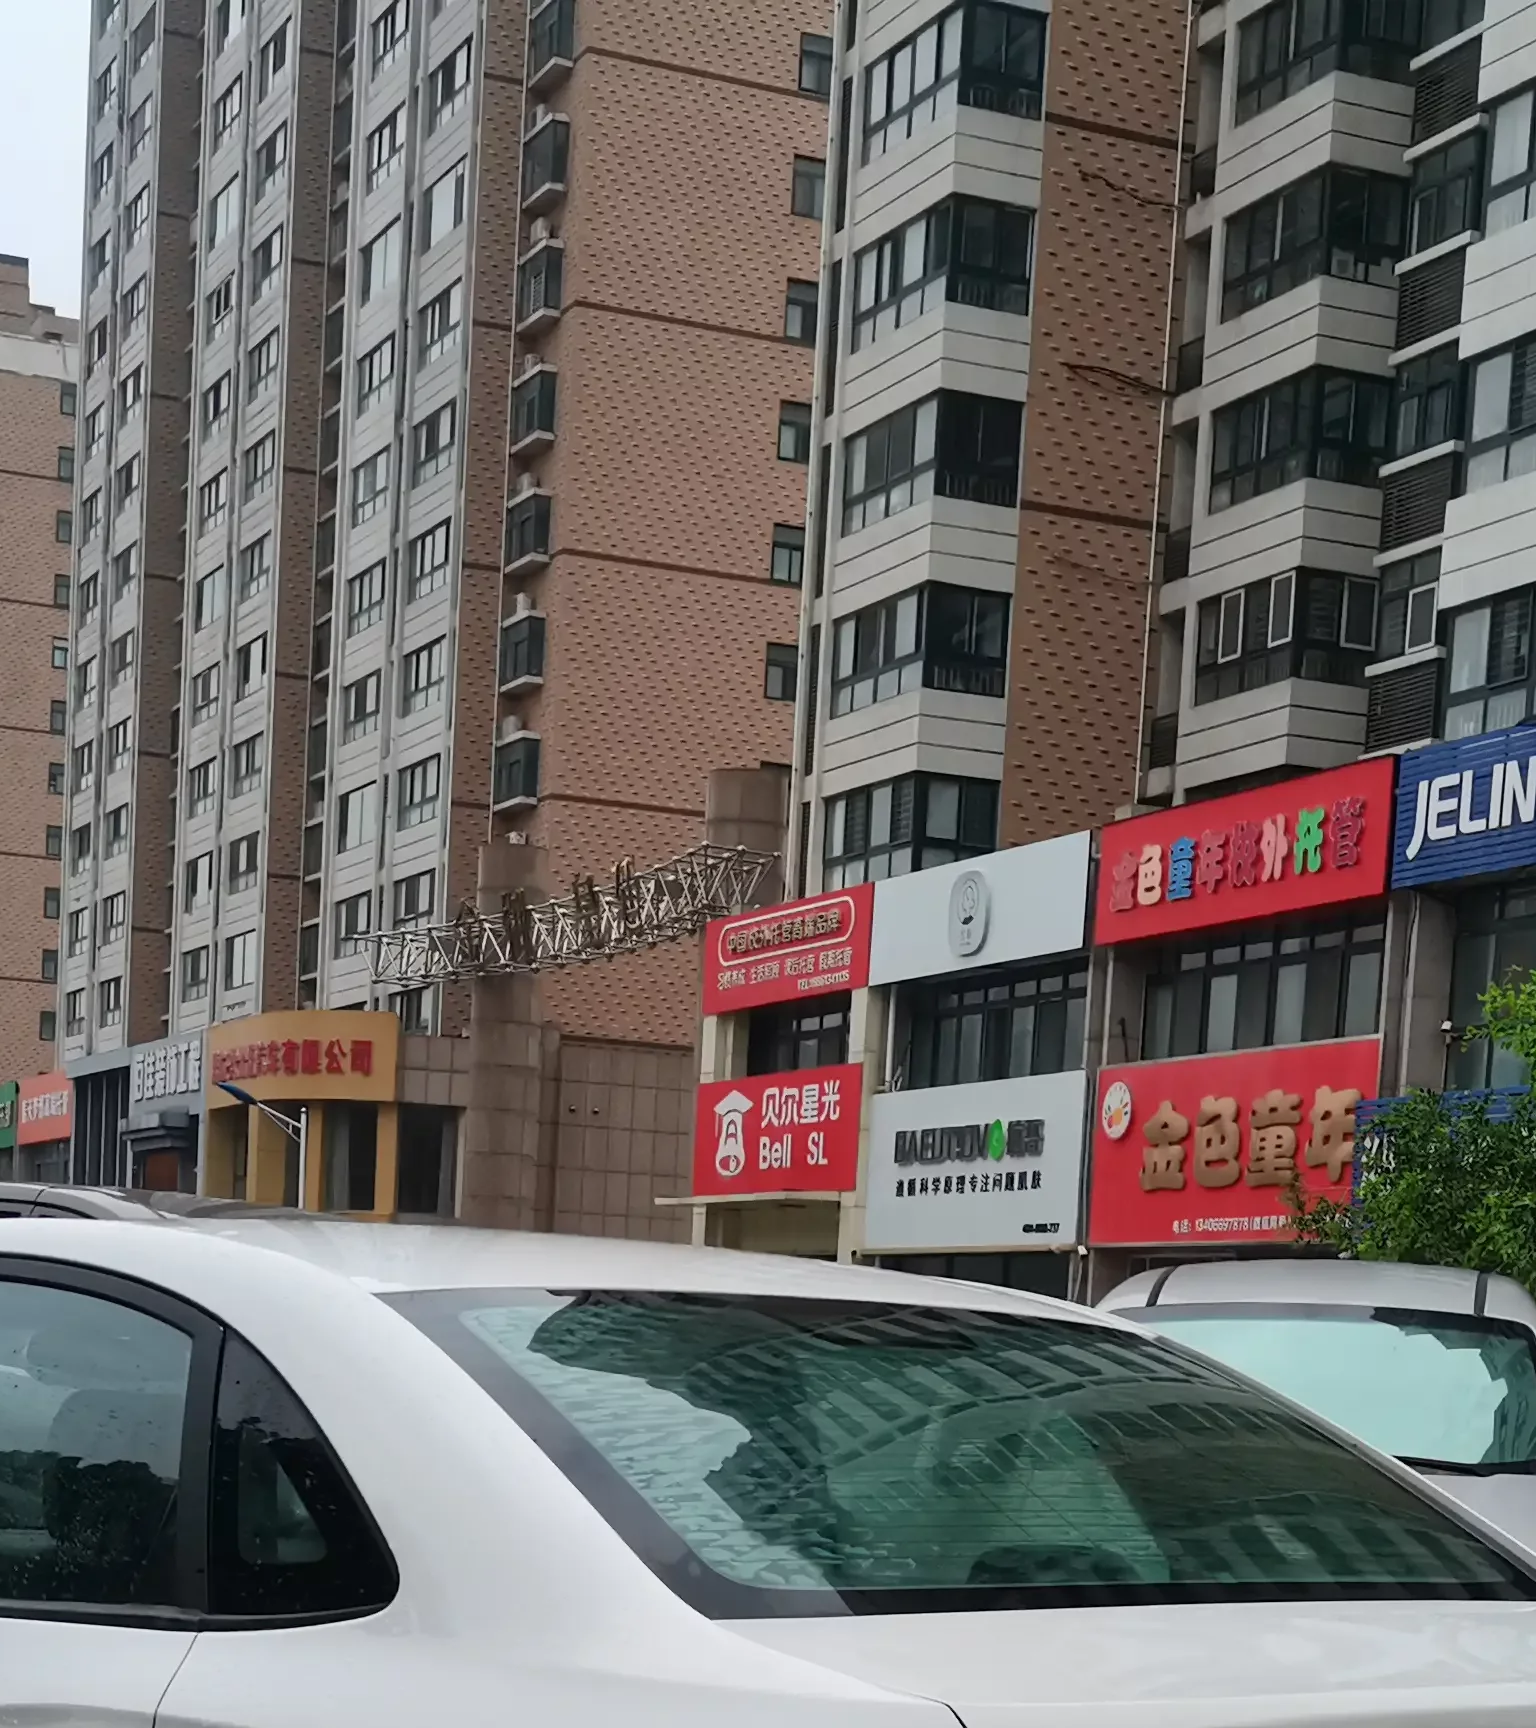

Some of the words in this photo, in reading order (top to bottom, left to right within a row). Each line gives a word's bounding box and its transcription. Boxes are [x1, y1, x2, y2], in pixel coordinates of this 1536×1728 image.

[1109, 796, 1364, 913] 金色童年校外托管
[761, 1079, 841, 1129] 贝尔星光
[1139, 1085, 1363, 1193] 金色童年
[758, 1133, 792, 1170] Bell
[806, 1131, 829, 1166] SL
